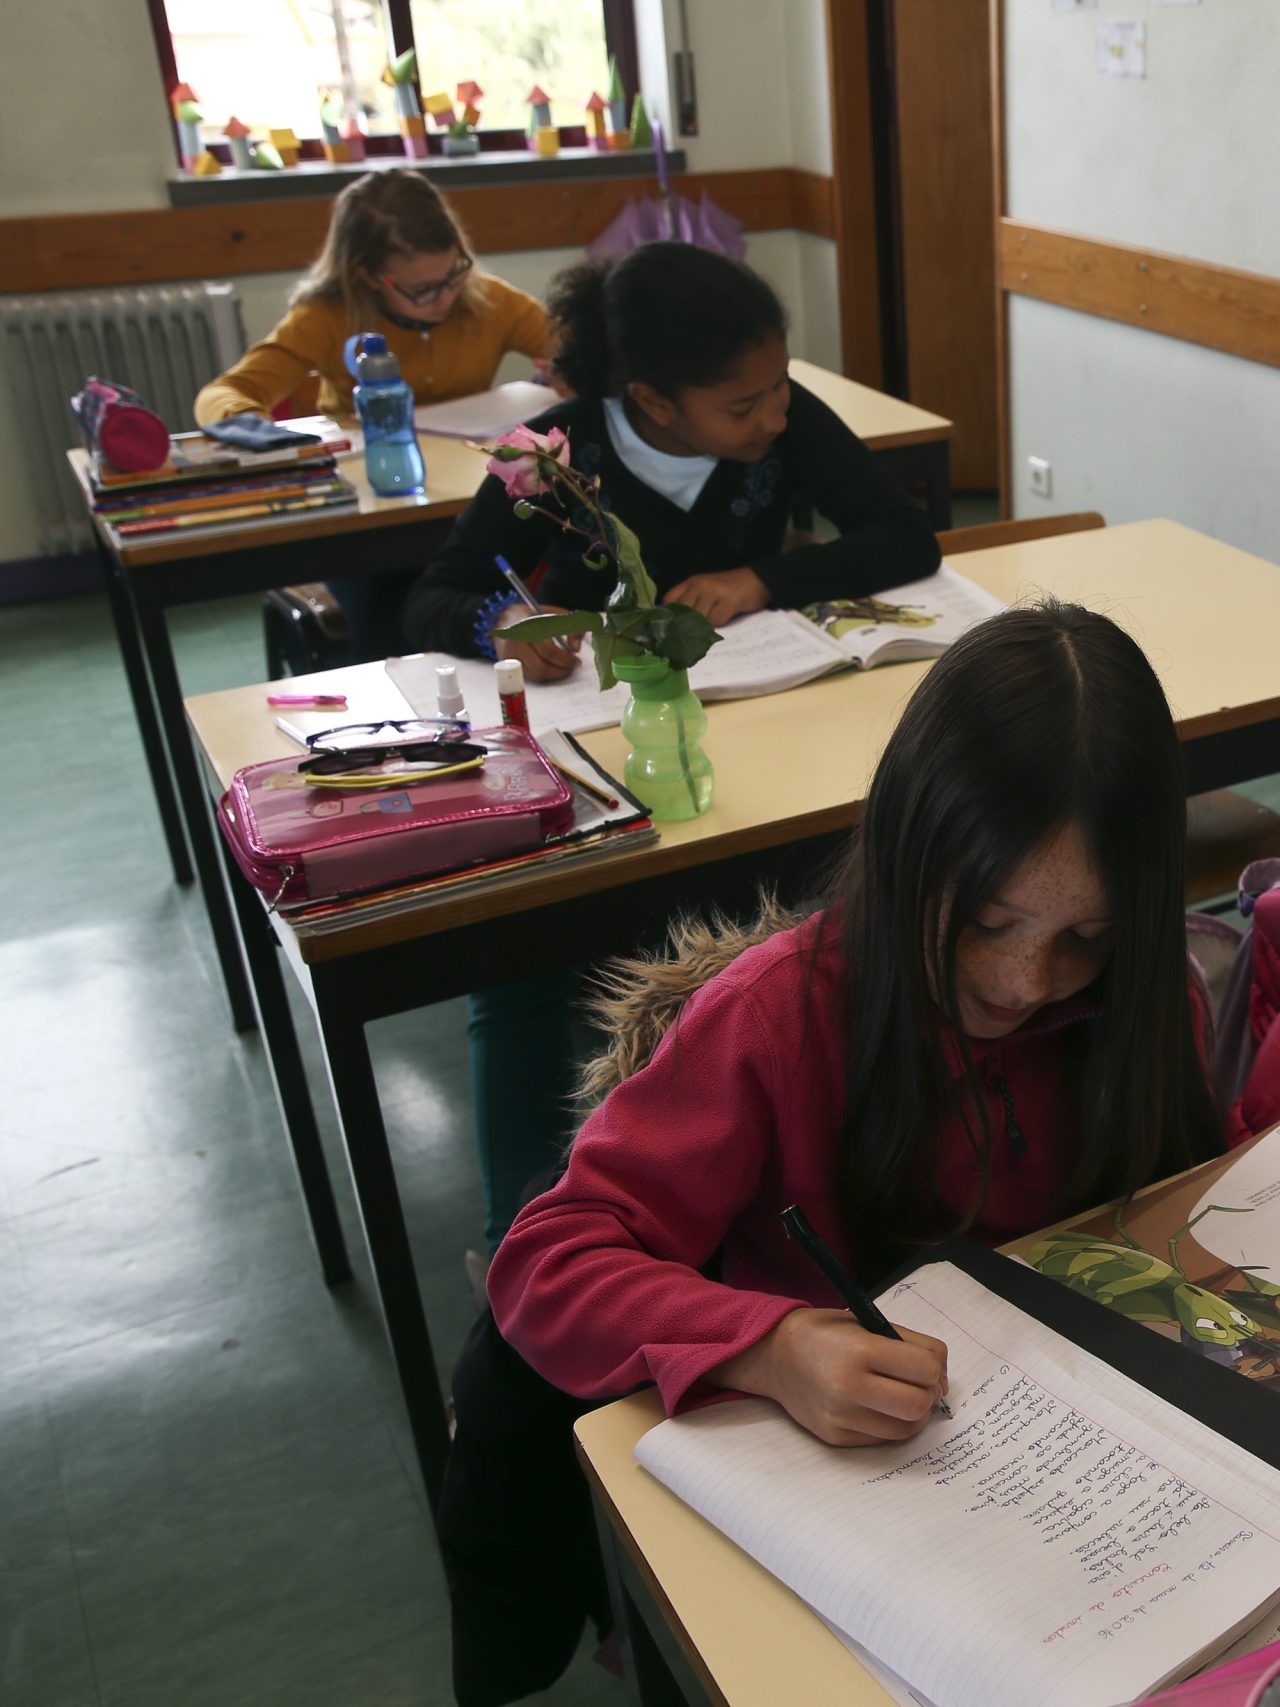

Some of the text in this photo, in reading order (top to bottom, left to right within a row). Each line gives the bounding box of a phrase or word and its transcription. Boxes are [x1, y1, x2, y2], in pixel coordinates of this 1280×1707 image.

[1073, 1442, 1128, 1487] tocando
[1096, 1465, 1133, 1495] clara
[1136, 1497, 1171, 1525] toca
[1156, 1513, 1191, 1542] belo
[1180, 1572, 1196, 1584] de
[1197, 1558, 1215, 1572] 12
[1110, 1559, 1172, 1602] Concerto
[1148, 1583, 1177, 1605] maio
[1088, 1600, 1106, 1614] de
[1131, 1603, 1147, 1616] de
[1096, 1612, 1134, 1641] 2016
